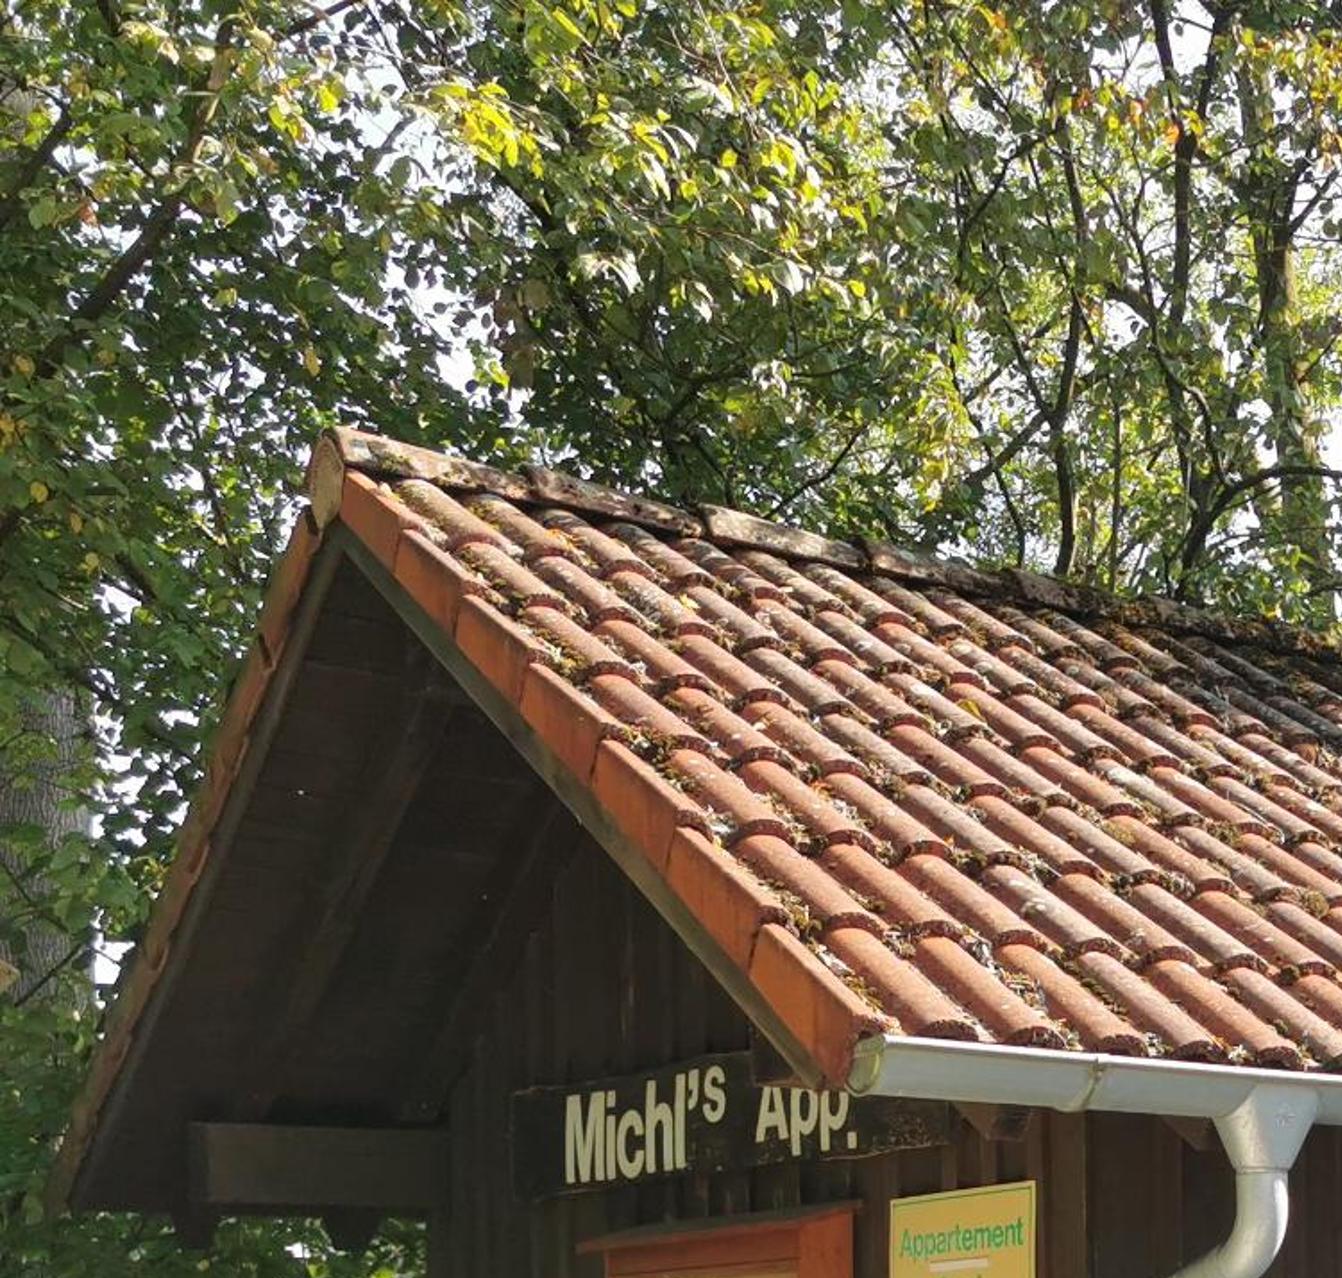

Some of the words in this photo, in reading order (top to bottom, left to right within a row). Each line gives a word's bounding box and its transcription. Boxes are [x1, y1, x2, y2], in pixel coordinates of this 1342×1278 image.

[565, 1065, 726, 1184] Michl's
[755, 1086, 857, 1156] App.
[900, 1217, 1024, 1261] Appartement
